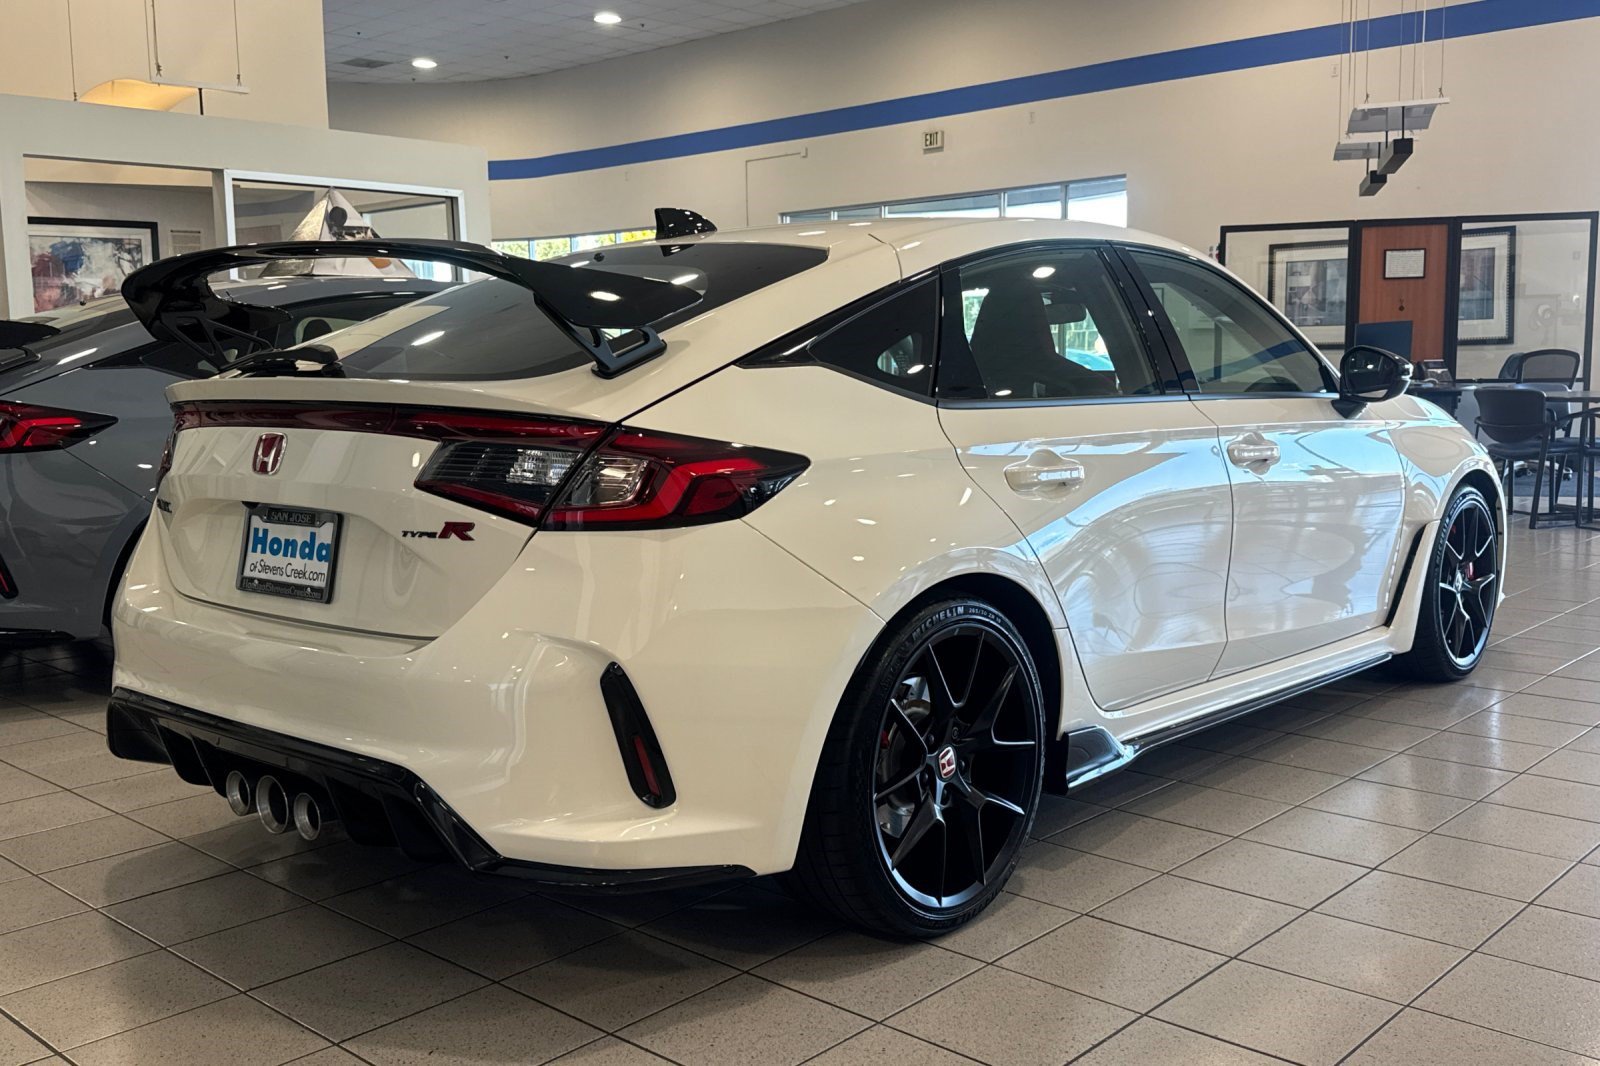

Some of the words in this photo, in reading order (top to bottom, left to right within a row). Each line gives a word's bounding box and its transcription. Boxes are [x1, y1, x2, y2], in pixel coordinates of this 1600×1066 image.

[925, 132, 938, 147] EXIT
[271, 511, 289, 521] SAN
[289, 512, 312, 523] JOSE
[402, 530, 438, 539] TYPE
[438, 521, 476, 541] R
[251, 527, 331, 563] Honda
[249, 561, 258, 573] of
[257, 559, 285, 577] Stevens
[284, 563, 326, 582] Creek.com
[911, 606, 965, 641] MICHELIN
